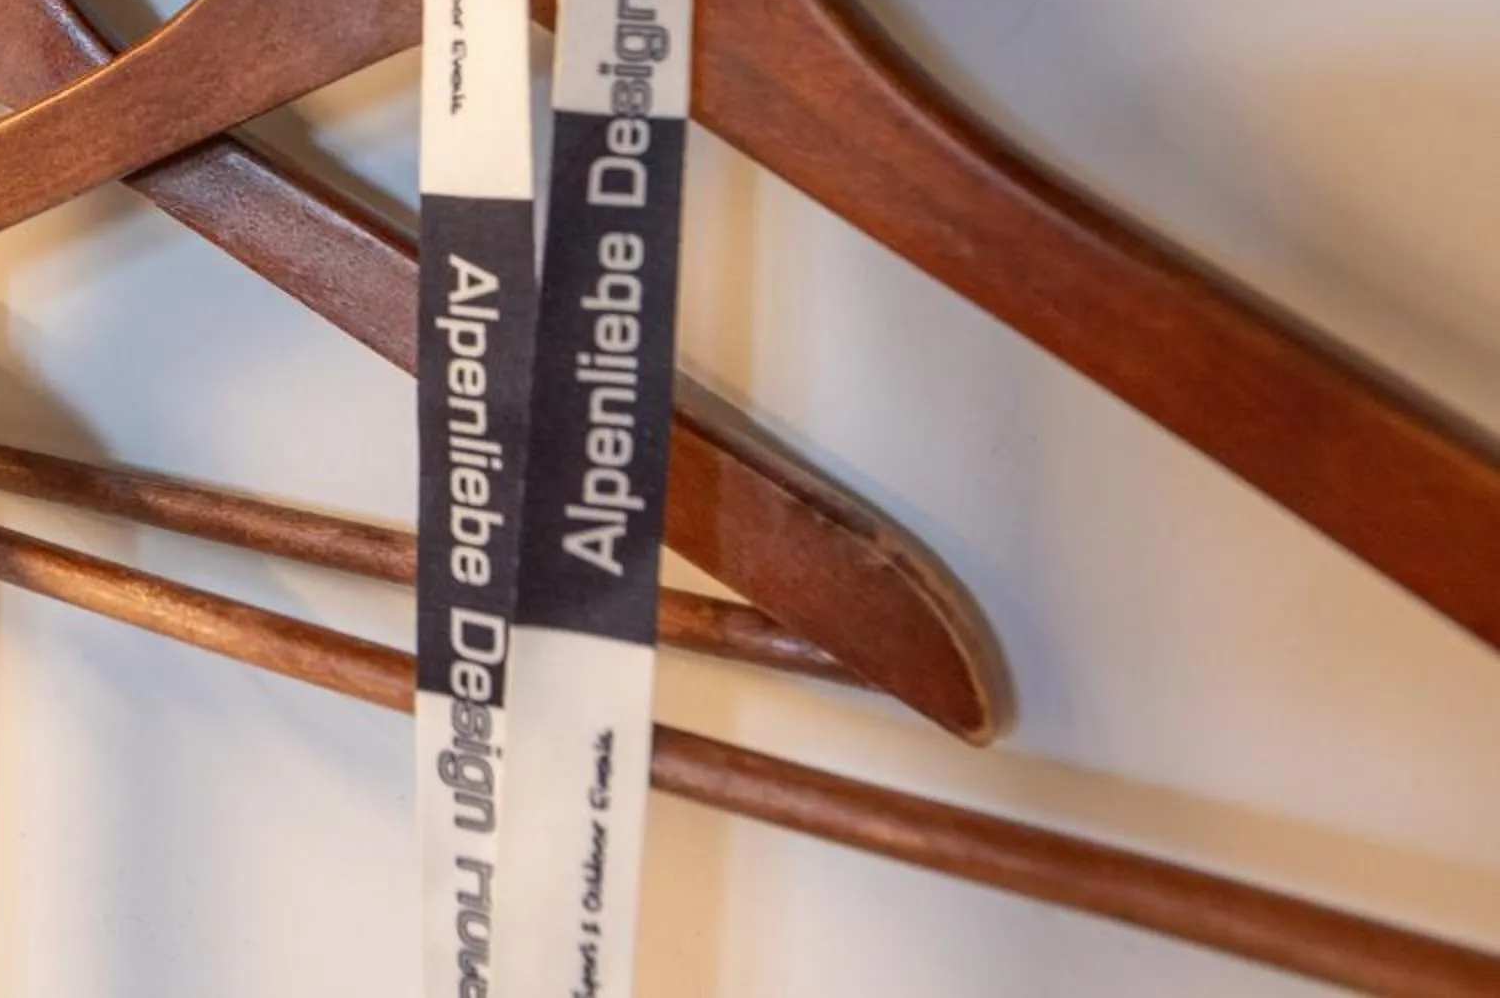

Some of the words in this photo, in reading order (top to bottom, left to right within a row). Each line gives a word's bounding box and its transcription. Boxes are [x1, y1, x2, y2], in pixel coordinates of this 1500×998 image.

[451, 39, 468, 116] Events
[435, 253, 504, 587] Alpenliebe
[562, 232, 644, 577] Alpenliebe
[437, 608, 506, 836] Design
